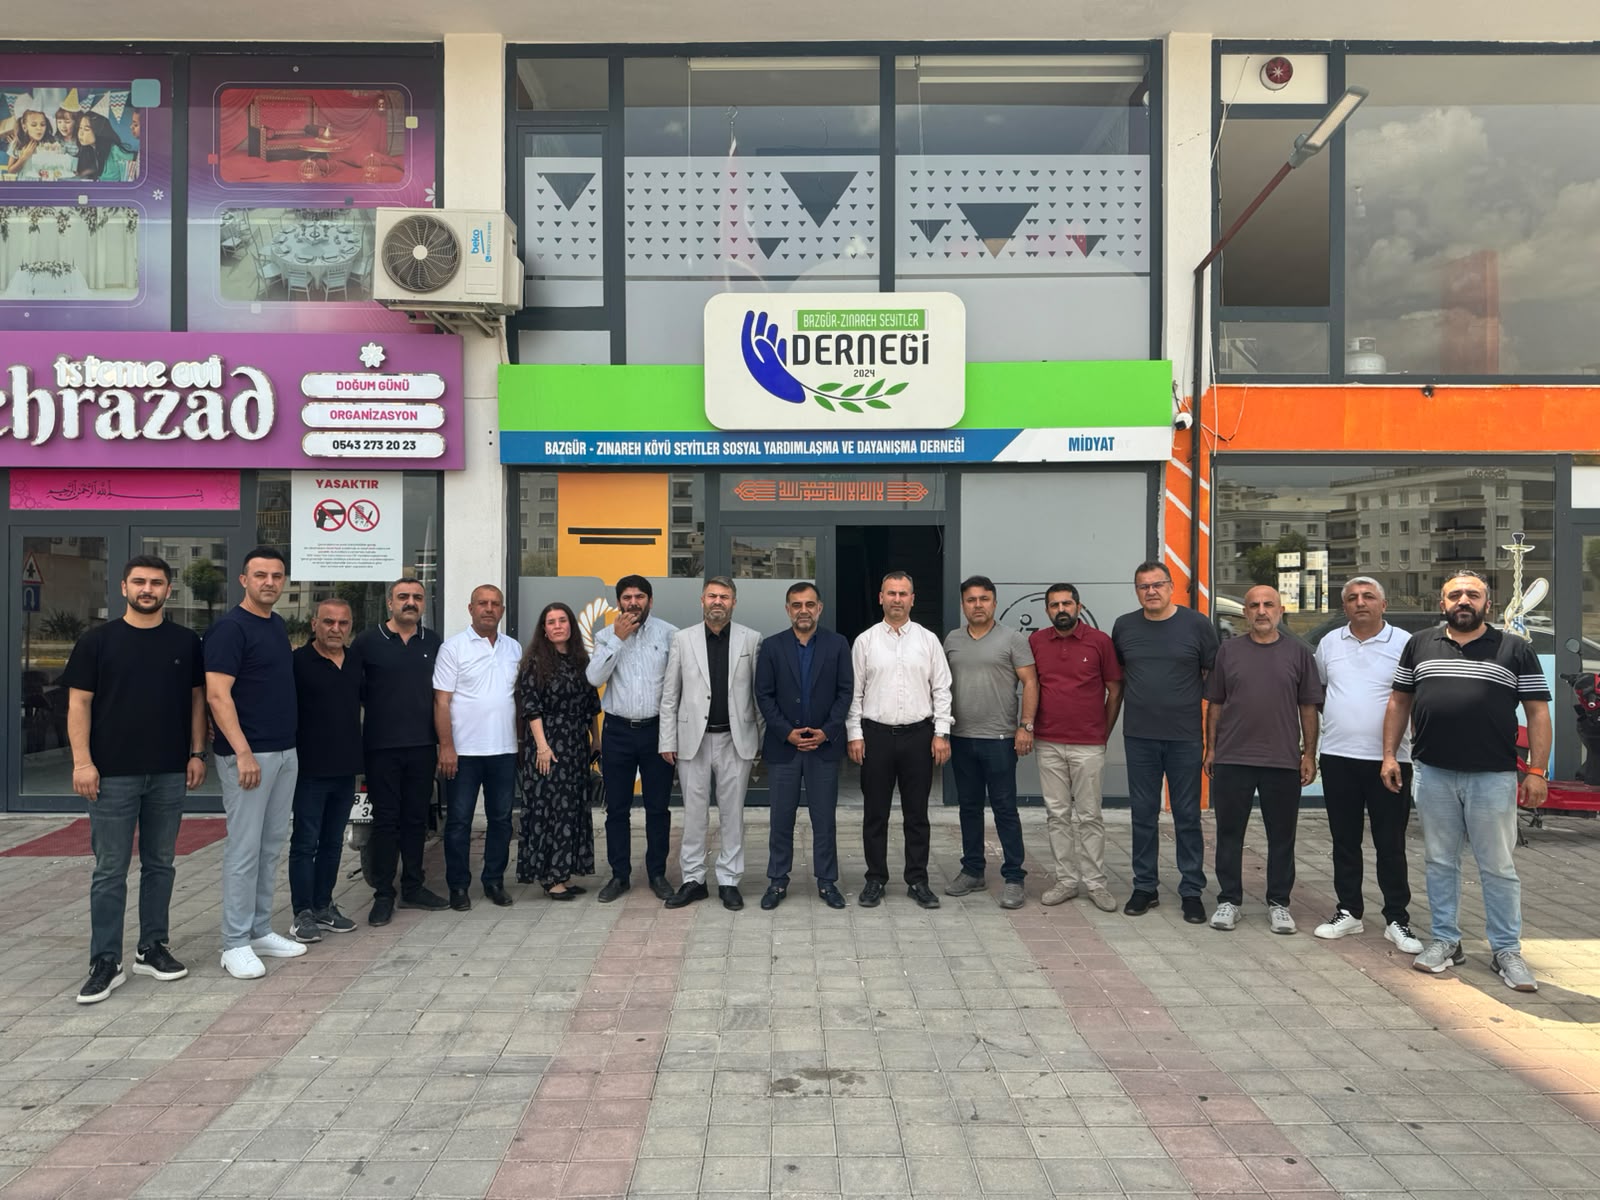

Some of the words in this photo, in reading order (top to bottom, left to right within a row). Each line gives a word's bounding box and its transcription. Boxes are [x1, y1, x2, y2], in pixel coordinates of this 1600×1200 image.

[471, 229, 480, 254] beko
[792, 333, 930, 366] DERNEĞİ
[853, 369, 876, 378] 2024
[336, 379, 376, 391] DOĞUM
[378, 378, 410, 391] GÜNÜ
[0, 365, 275, 446] hrazad
[329, 408, 418, 420] ORGANİZASYON
[332, 440, 361, 450] 0543
[363, 440, 384, 450] 273
[386, 440, 400, 450] 20
[402, 440, 416, 450] 23
[544, 439, 587, 455] BAZGÜR
[596, 441, 642, 456] ZINAREH
[644, 439, 671, 456] KÖYÜ
[673, 439, 720, 456] SEYİTLER
[722, 441, 762, 456] SOSYAL
[763, 440, 839, 456] YARDIMLAŞMA
[841, 440, 855, 454] VE
[857, 439, 917, 456] DAYANIŞMA
[919, 436, 965, 454] DERNEĞİ
[1068, 434, 1115, 452] MİDYAT
[315, 479, 379, 489] YASAKTIR
